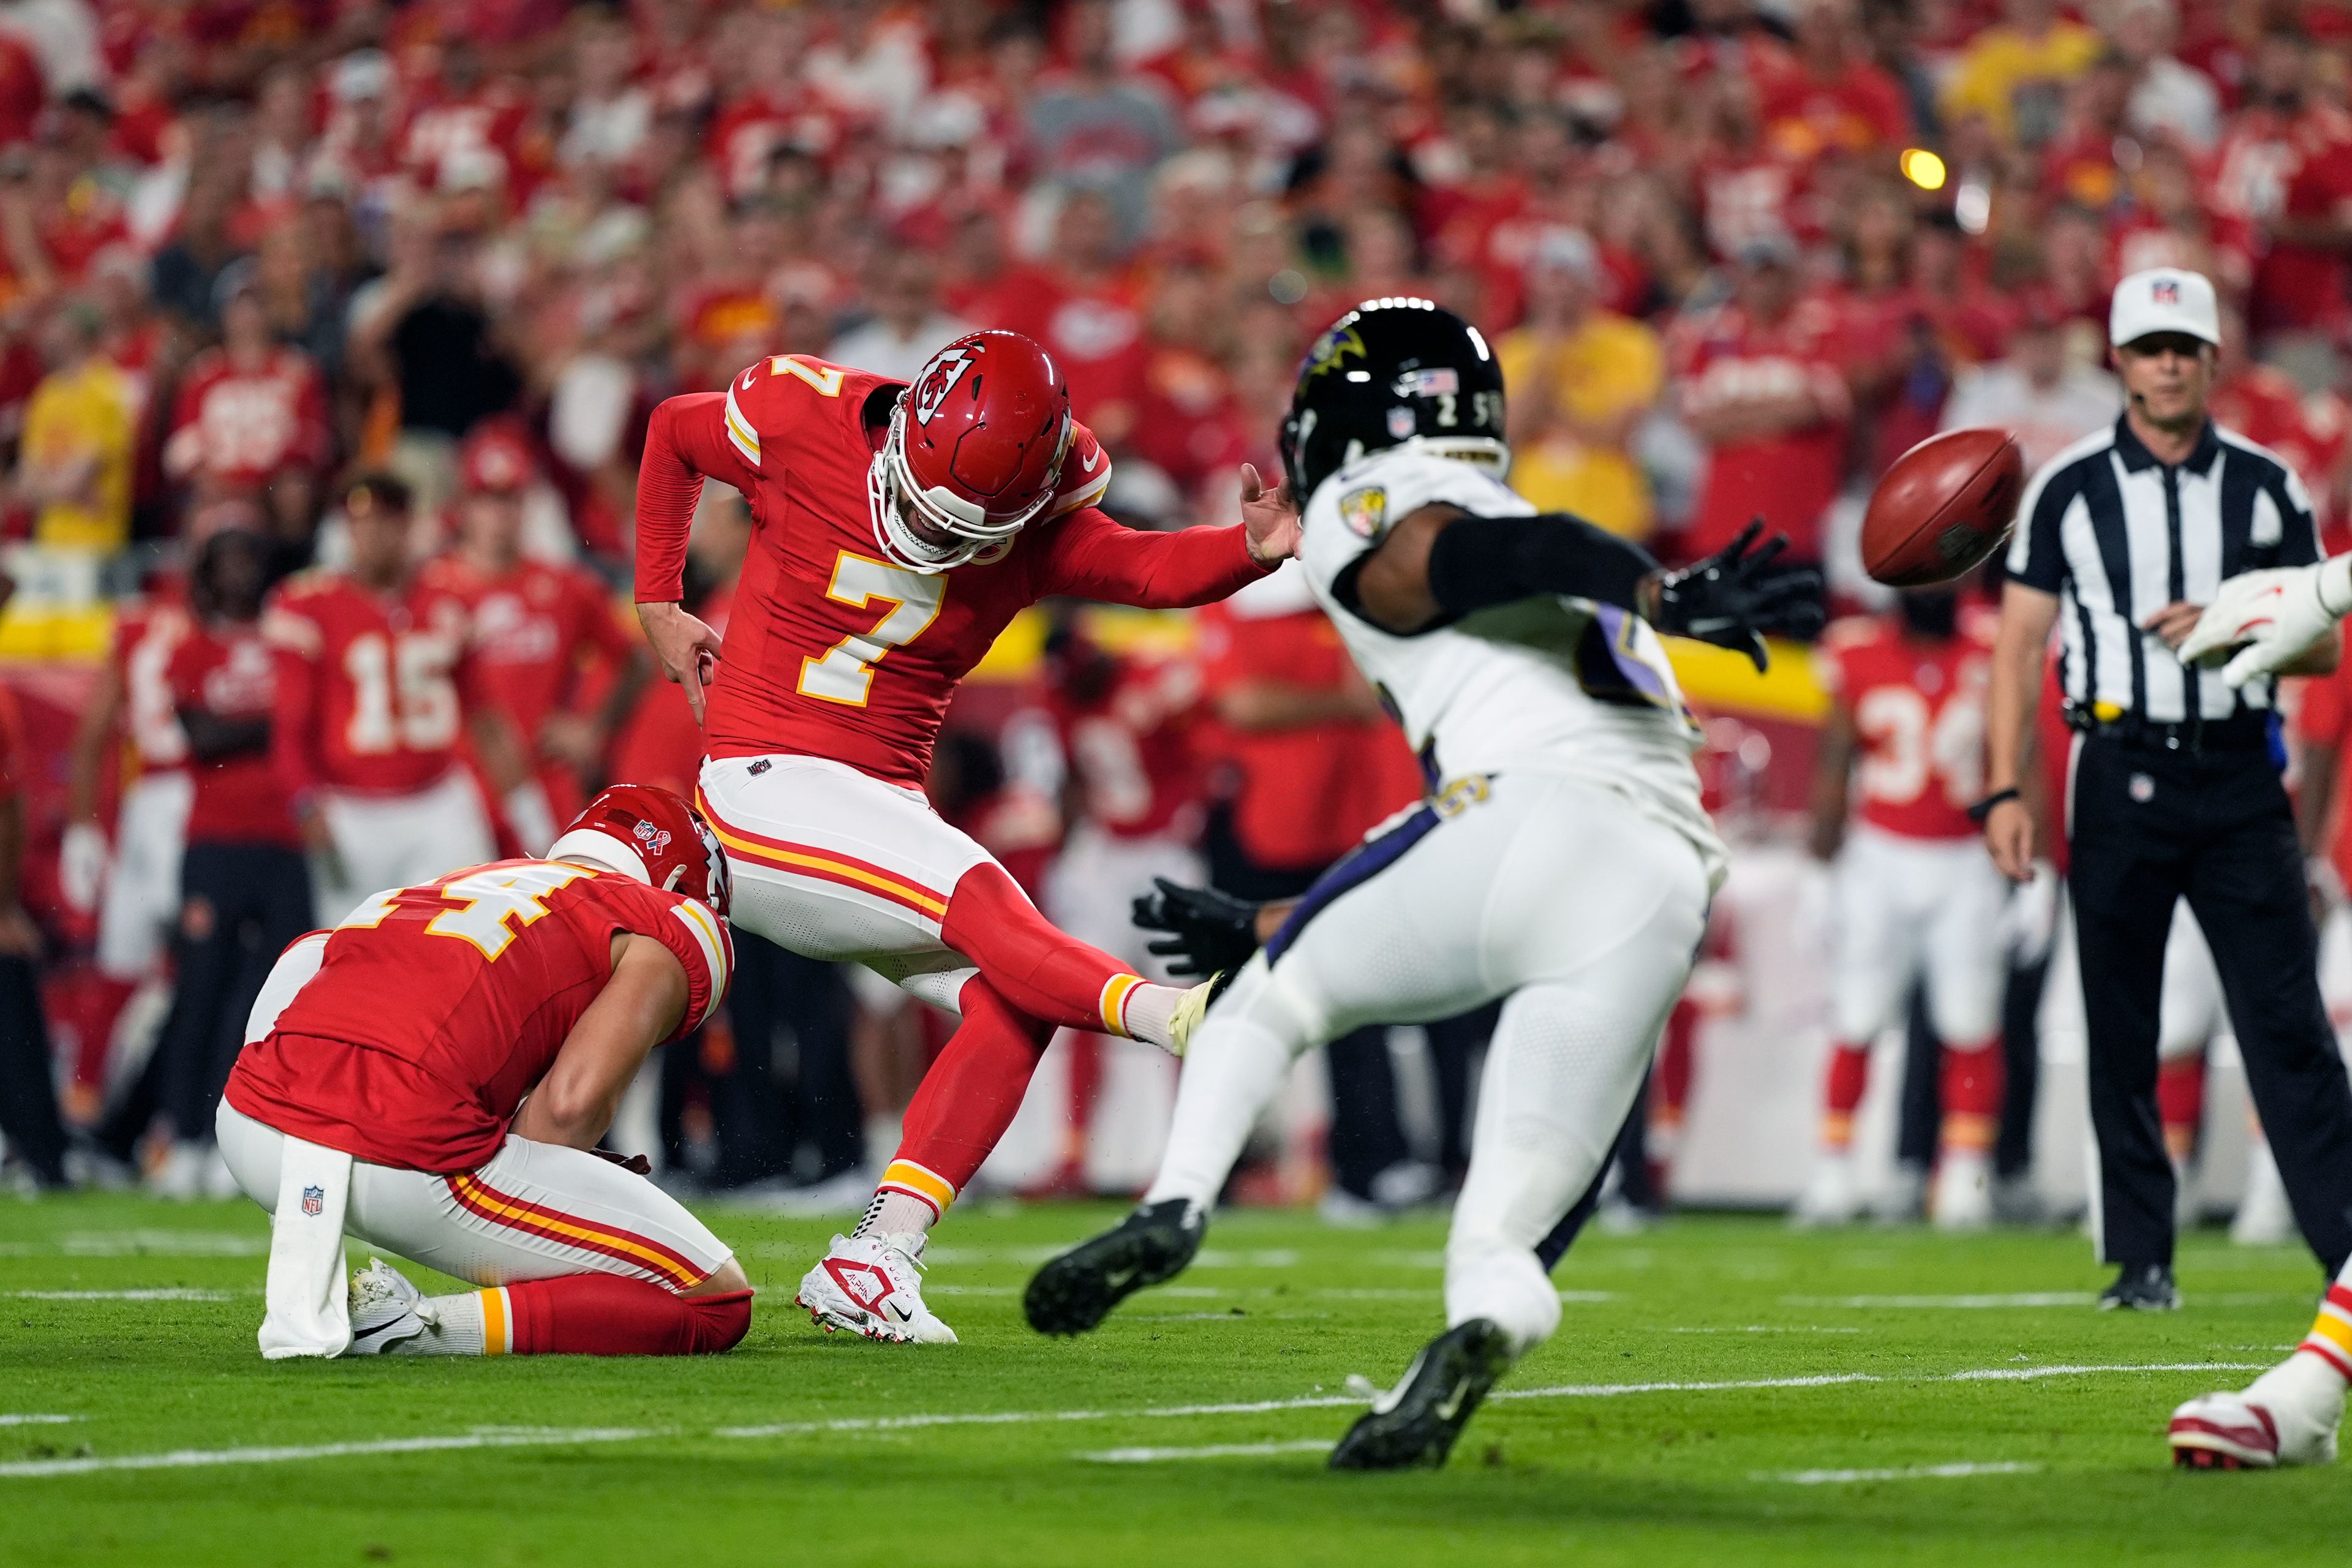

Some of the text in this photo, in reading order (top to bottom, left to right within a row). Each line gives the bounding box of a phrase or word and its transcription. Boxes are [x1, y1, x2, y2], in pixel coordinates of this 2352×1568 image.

[771, 356, 845, 398] 7
[918, 359, 960, 410] KC
[796, 549, 949, 707] 7
[344, 633, 461, 752] 15
[636, 826, 650, 839] NFL
[304, 1198, 320, 1213] NFL
